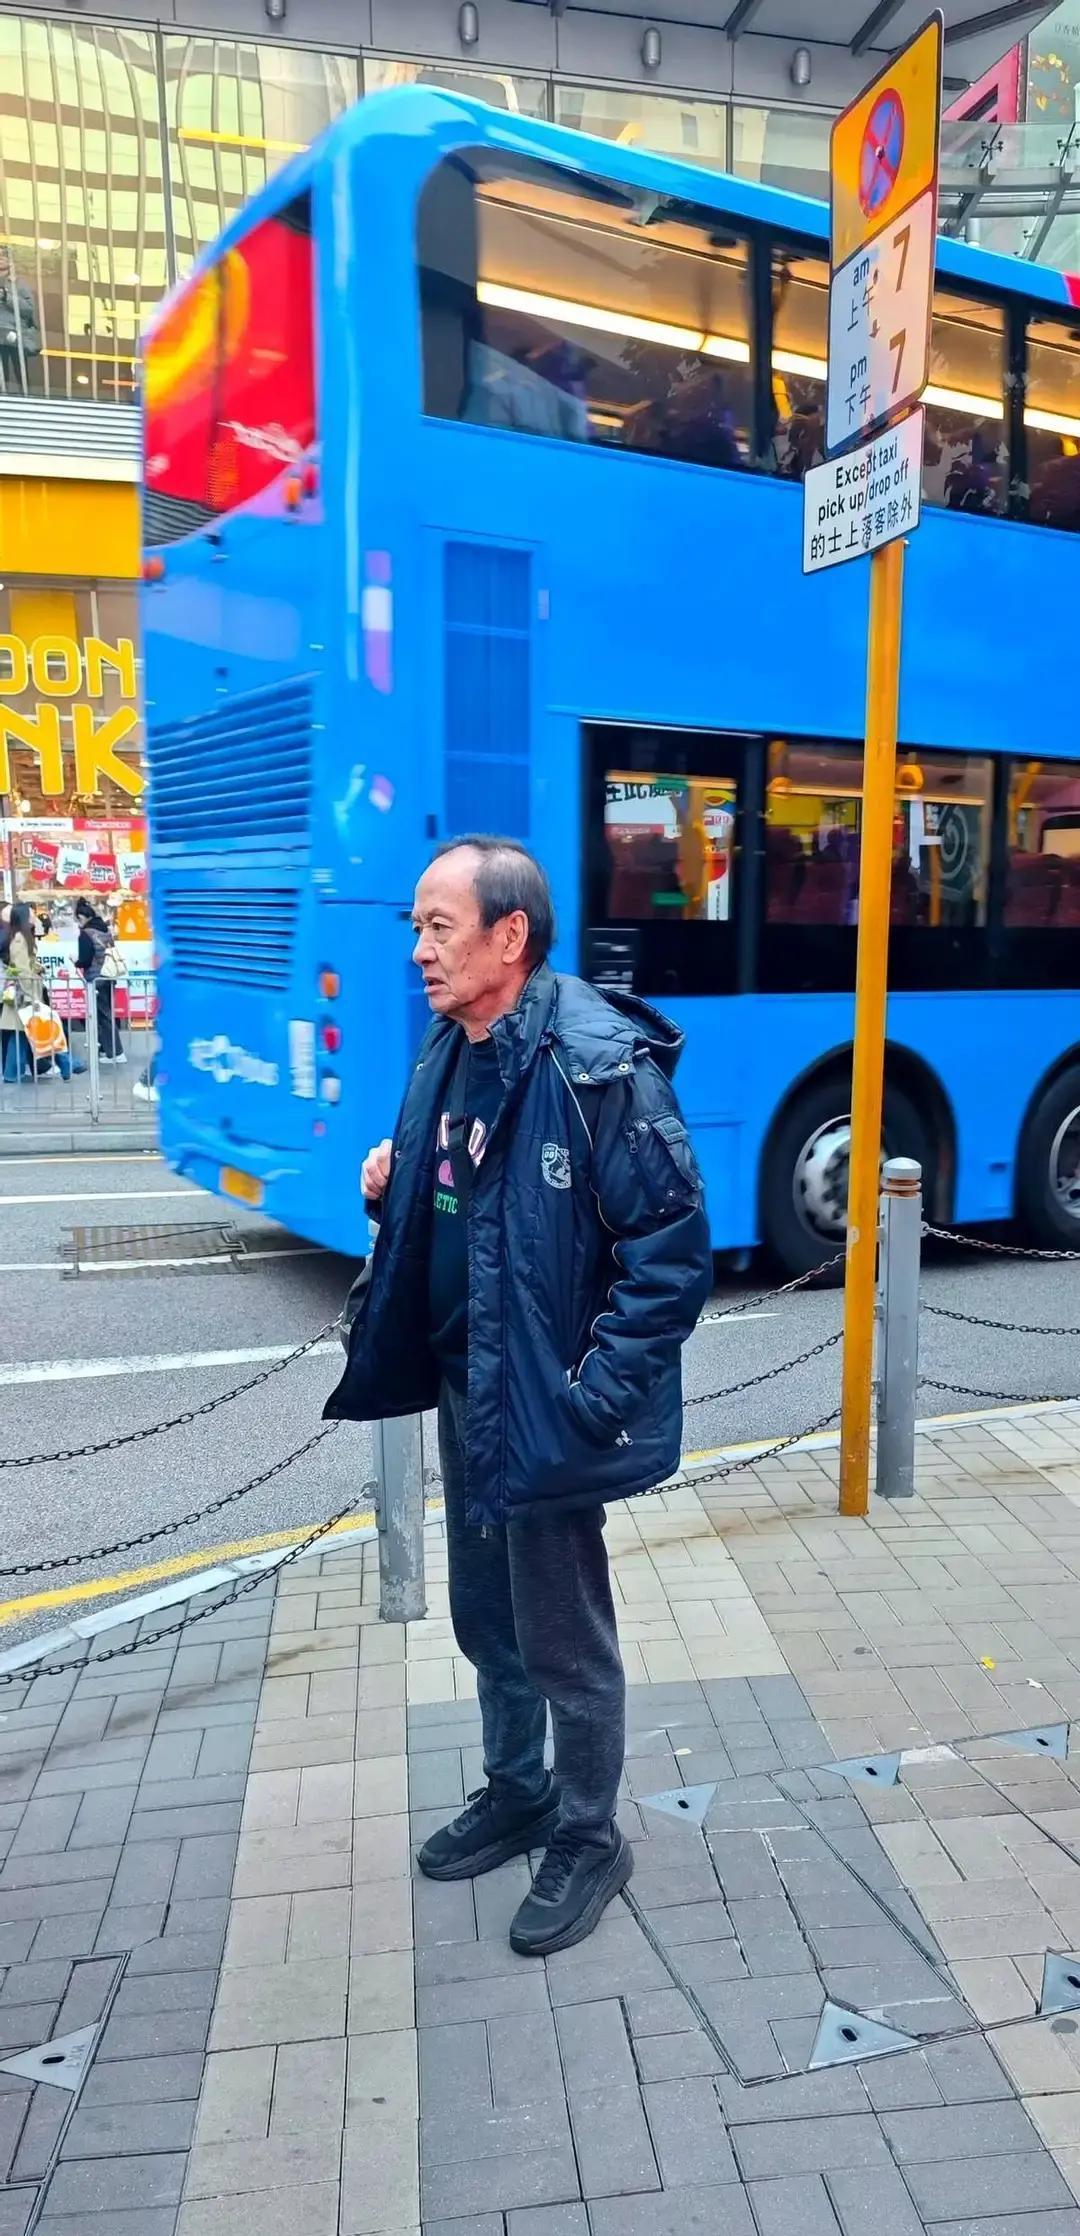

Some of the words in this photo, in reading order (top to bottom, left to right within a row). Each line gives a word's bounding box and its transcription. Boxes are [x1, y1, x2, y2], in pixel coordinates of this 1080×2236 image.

[853, 257, 870, 286] am
[893, 224, 910, 292] 7
[847, 283, 874, 332] 上午
[850, 355, 867, 388] pm
[889, 328, 906, 394] 7
[845, 384, 872, 425] 下午
[835, 454, 877, 489] Except
[879, 437, 898, 468] taxi
[818, 494, 846, 526] pick
[894, 457, 909, 486] off
[810, 490, 913, 560] 的士上落客除外
